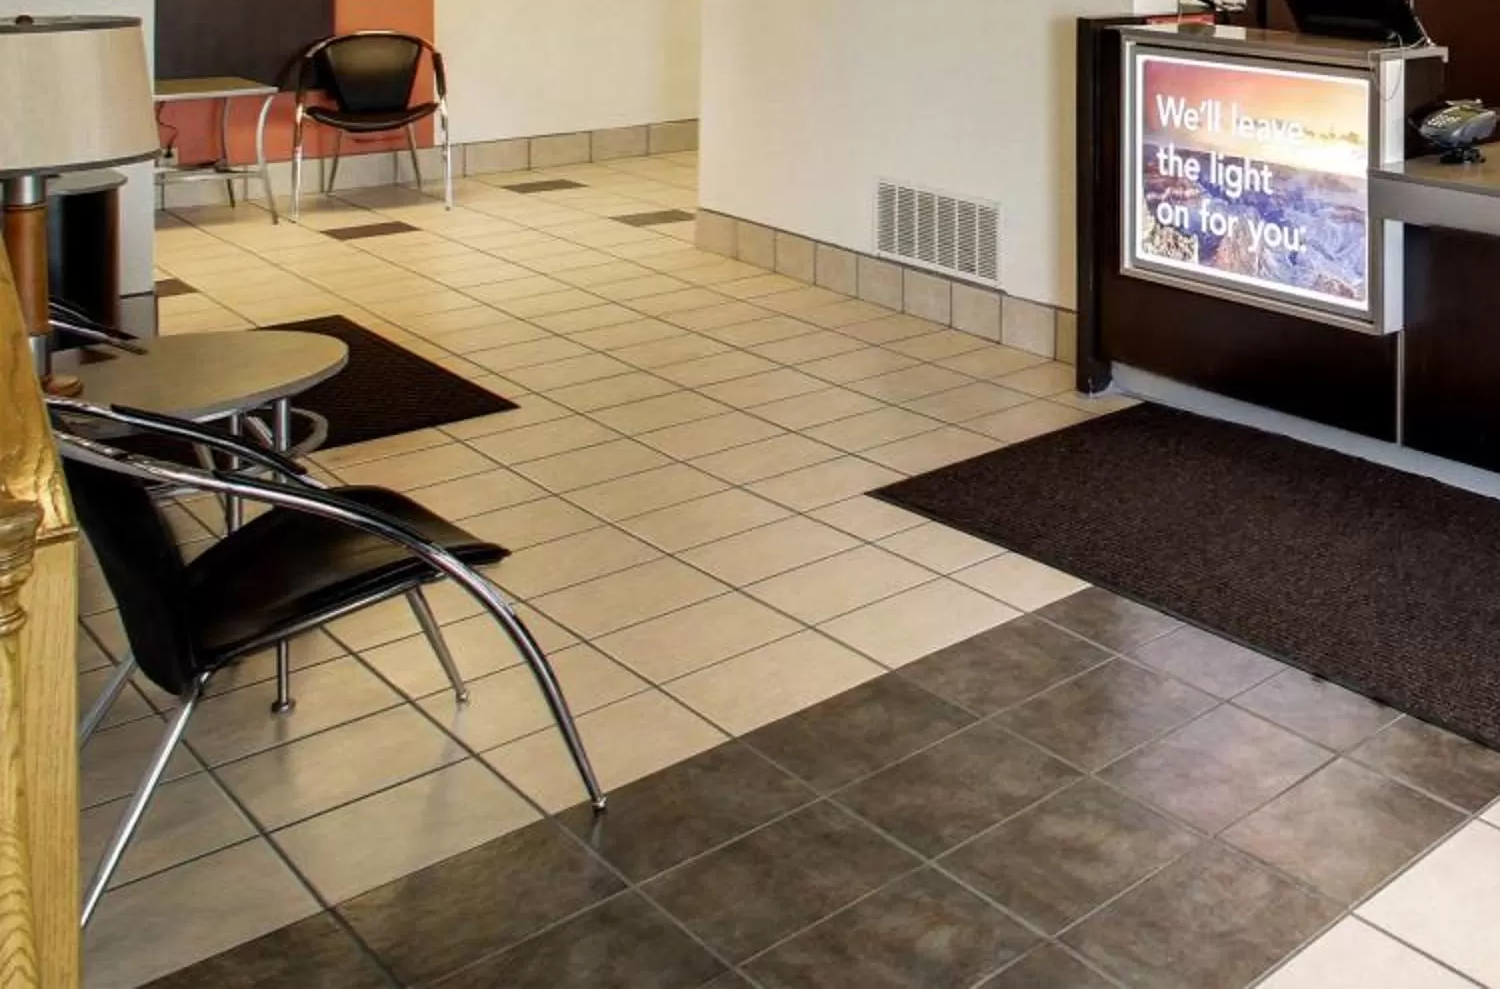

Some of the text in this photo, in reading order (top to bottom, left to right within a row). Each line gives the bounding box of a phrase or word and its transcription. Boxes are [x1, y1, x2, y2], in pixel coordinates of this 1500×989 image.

[1231, 101, 1305, 142] leave
[1156, 143, 1274, 199] the light
[1156, 202, 1189, 228] on
[1198, 198, 1238, 238] for
